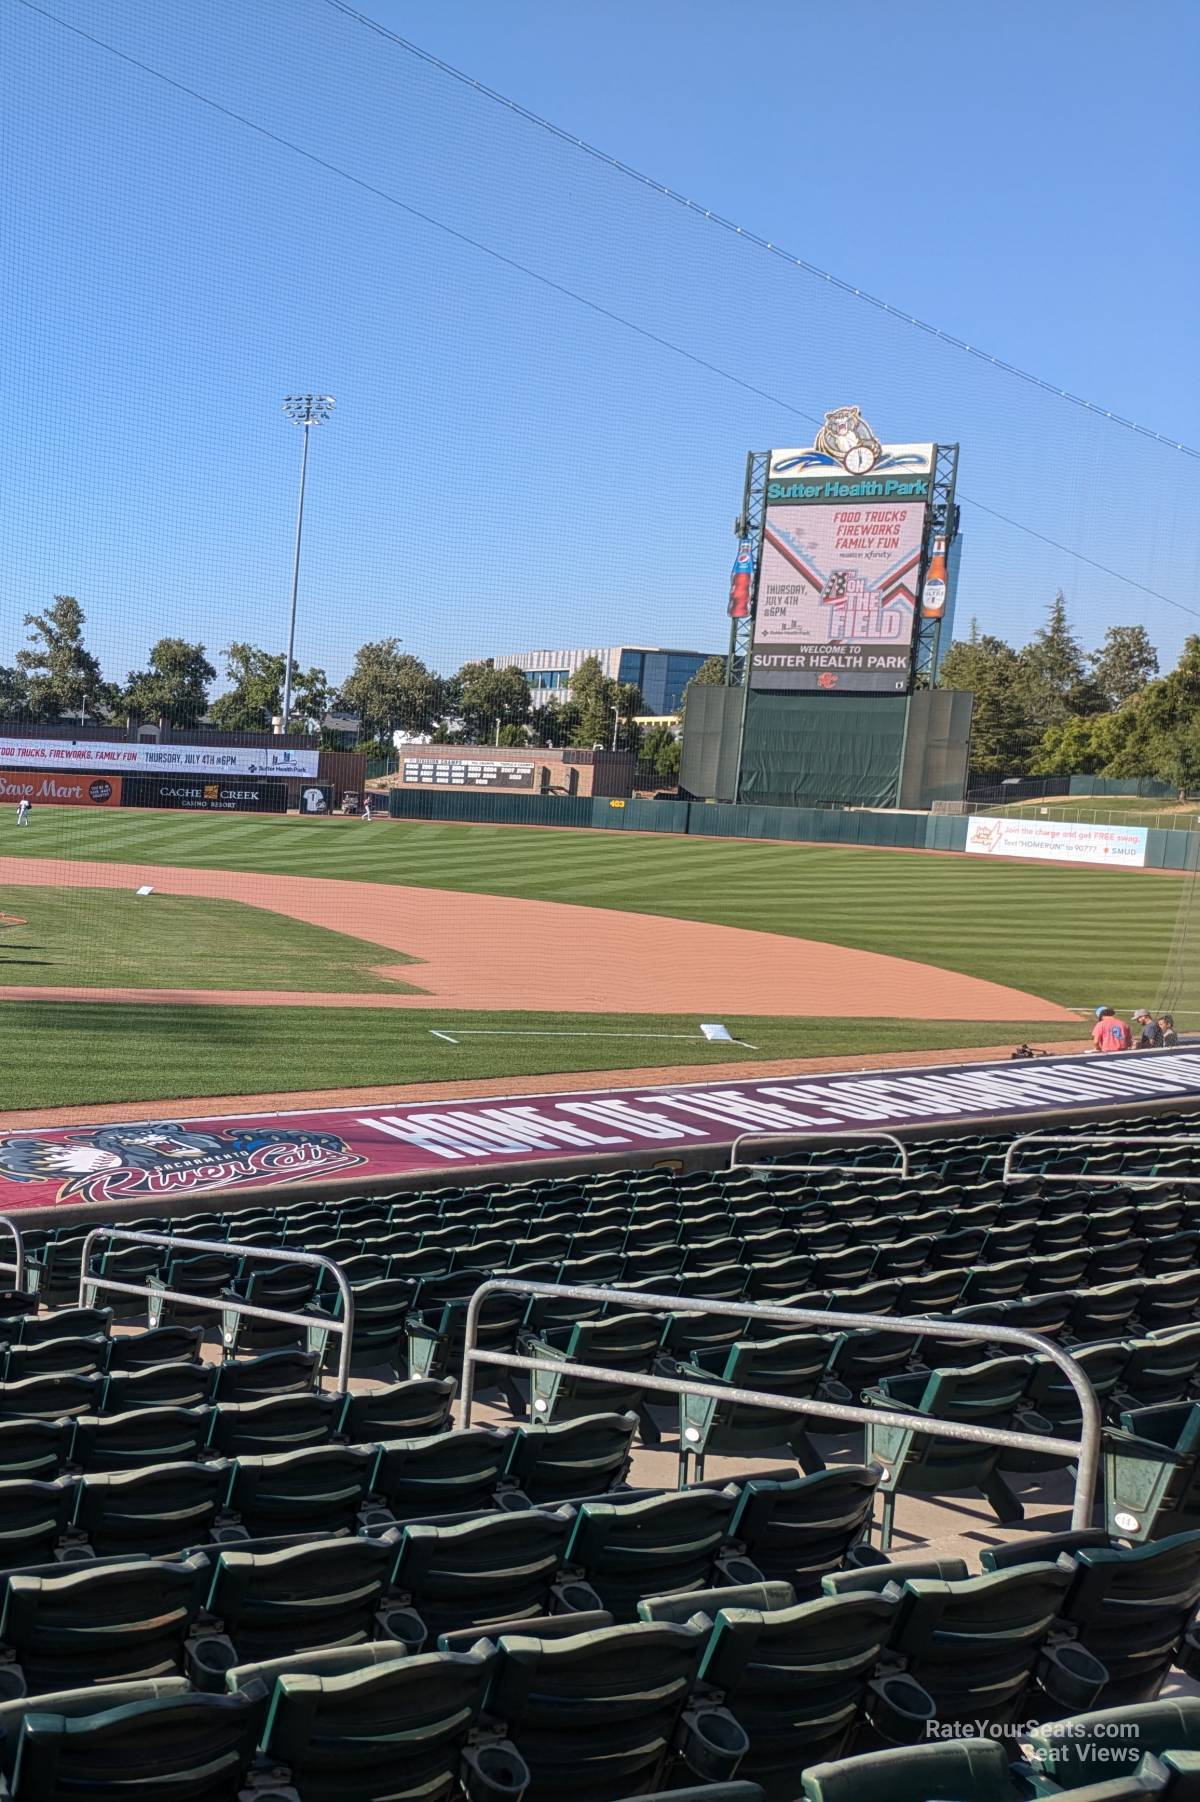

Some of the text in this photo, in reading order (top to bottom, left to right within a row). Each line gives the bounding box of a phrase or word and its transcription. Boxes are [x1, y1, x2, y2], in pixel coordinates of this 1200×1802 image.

[767, 479, 928, 499] Sutter Health Park
[833, 510, 907, 523] FOOD TRUCKS
[836, 524, 901, 536] FIREWORKS
[835, 537, 899, 549] FAMILY FUN
[864, 550, 892, 560] xfinity
[766, 584, 808, 596] THURSDAY,
[765, 596, 799, 606] JULY 4TH
[846, 592, 880, 611] THE
[830, 610, 901, 638] FIELD
[799, 645, 862, 654] WELCOME TO
[753, 654, 907, 669] SUTTER HEALTH PARK
[17, 747, 47, 758] TRUCKS,
[95, 751, 121, 761] FAMILY
[122, 752, 138, 761] FUN
[145, 751, 183, 765] THURSDAY,
[184, 754, 200, 765] JULY
[202, 754, 215, 765] 4TH
[36, 779, 84, 799] Mart
[160, 787, 259, 800] CACHE CREEK
[1005, 826, 1020, 834] Join
[1021, 827, 1034, 835] the
[1035, 829, 1060, 839] charge
[1078, 832, 1092, 840] get
[1094, 832, 1115, 841] FREE
[1004, 839, 1017, 847] Text
[1074, 845, 1097, 853] 90777
[1112, 848, 1136, 856] SMUD
[357, 1106, 632, 1159] HOME
[554, 1100, 711, 1140] OF
[634, 1090, 846, 1130] THE
[757, 1064, 1188, 1121] SACRAMENTO
[153, 1149, 250, 1172] SACRAMENTO
[69, 1142, 352, 1202] River Cats
